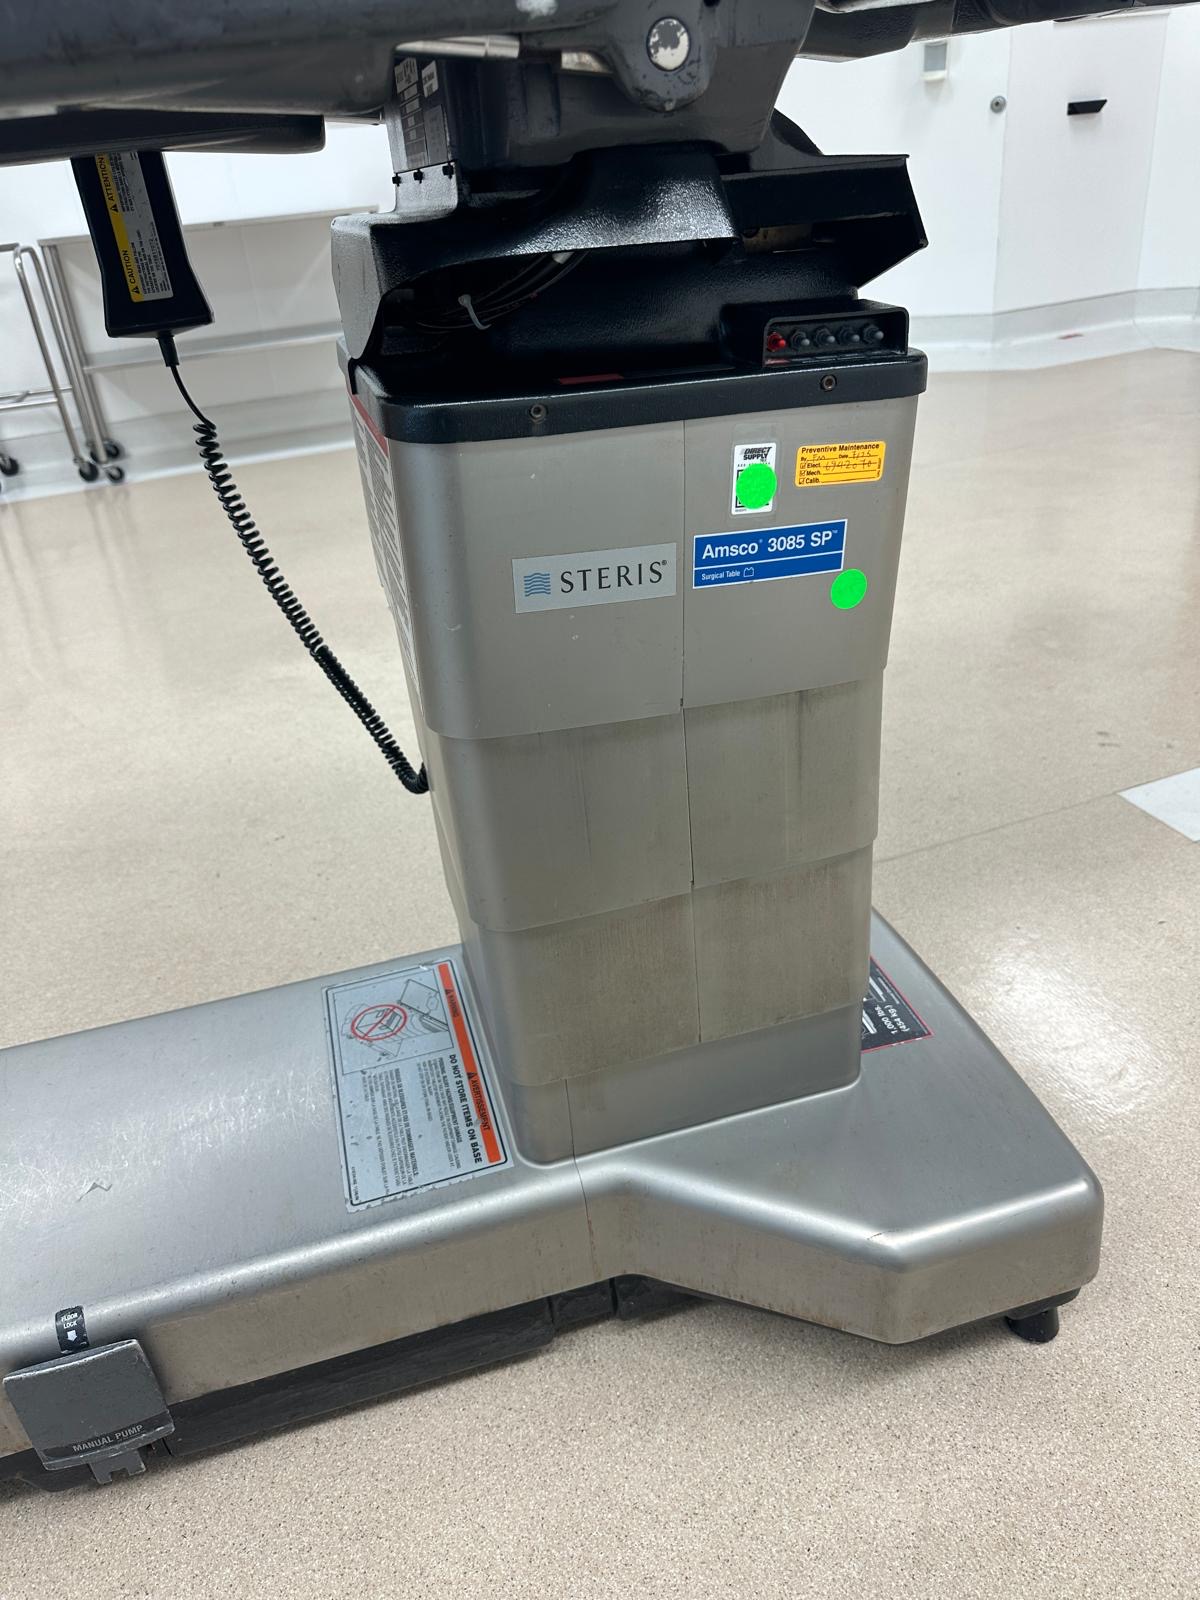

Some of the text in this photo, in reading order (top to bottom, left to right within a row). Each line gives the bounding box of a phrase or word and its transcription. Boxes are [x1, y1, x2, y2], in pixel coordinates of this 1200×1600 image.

[97, 156, 114, 201] ATTENTION
[121, 249, 136, 284] CAUTION
[744, 446, 772, 454] DIRECT
[801, 442, 880, 454] Preventive Maintenance
[743, 453, 768, 461] SUPPLY
[768, 534, 805, 552] 3085
[702, 570, 740, 580] Surgical Table
[882, 1017, 898, 1034] 1,000
[894, 1018, 910, 1032] (454
[448, 1053, 483, 1164] DO NOT STORE ITEMS ON BASE
[469, 1078, 490, 1132] AVERTISSEMENT
[61, 1312, 78, 1322] FLOOR
[63, 1320, 78, 1329] LOCK
[72, 1424, 143, 1452] MANUAL PUMP
